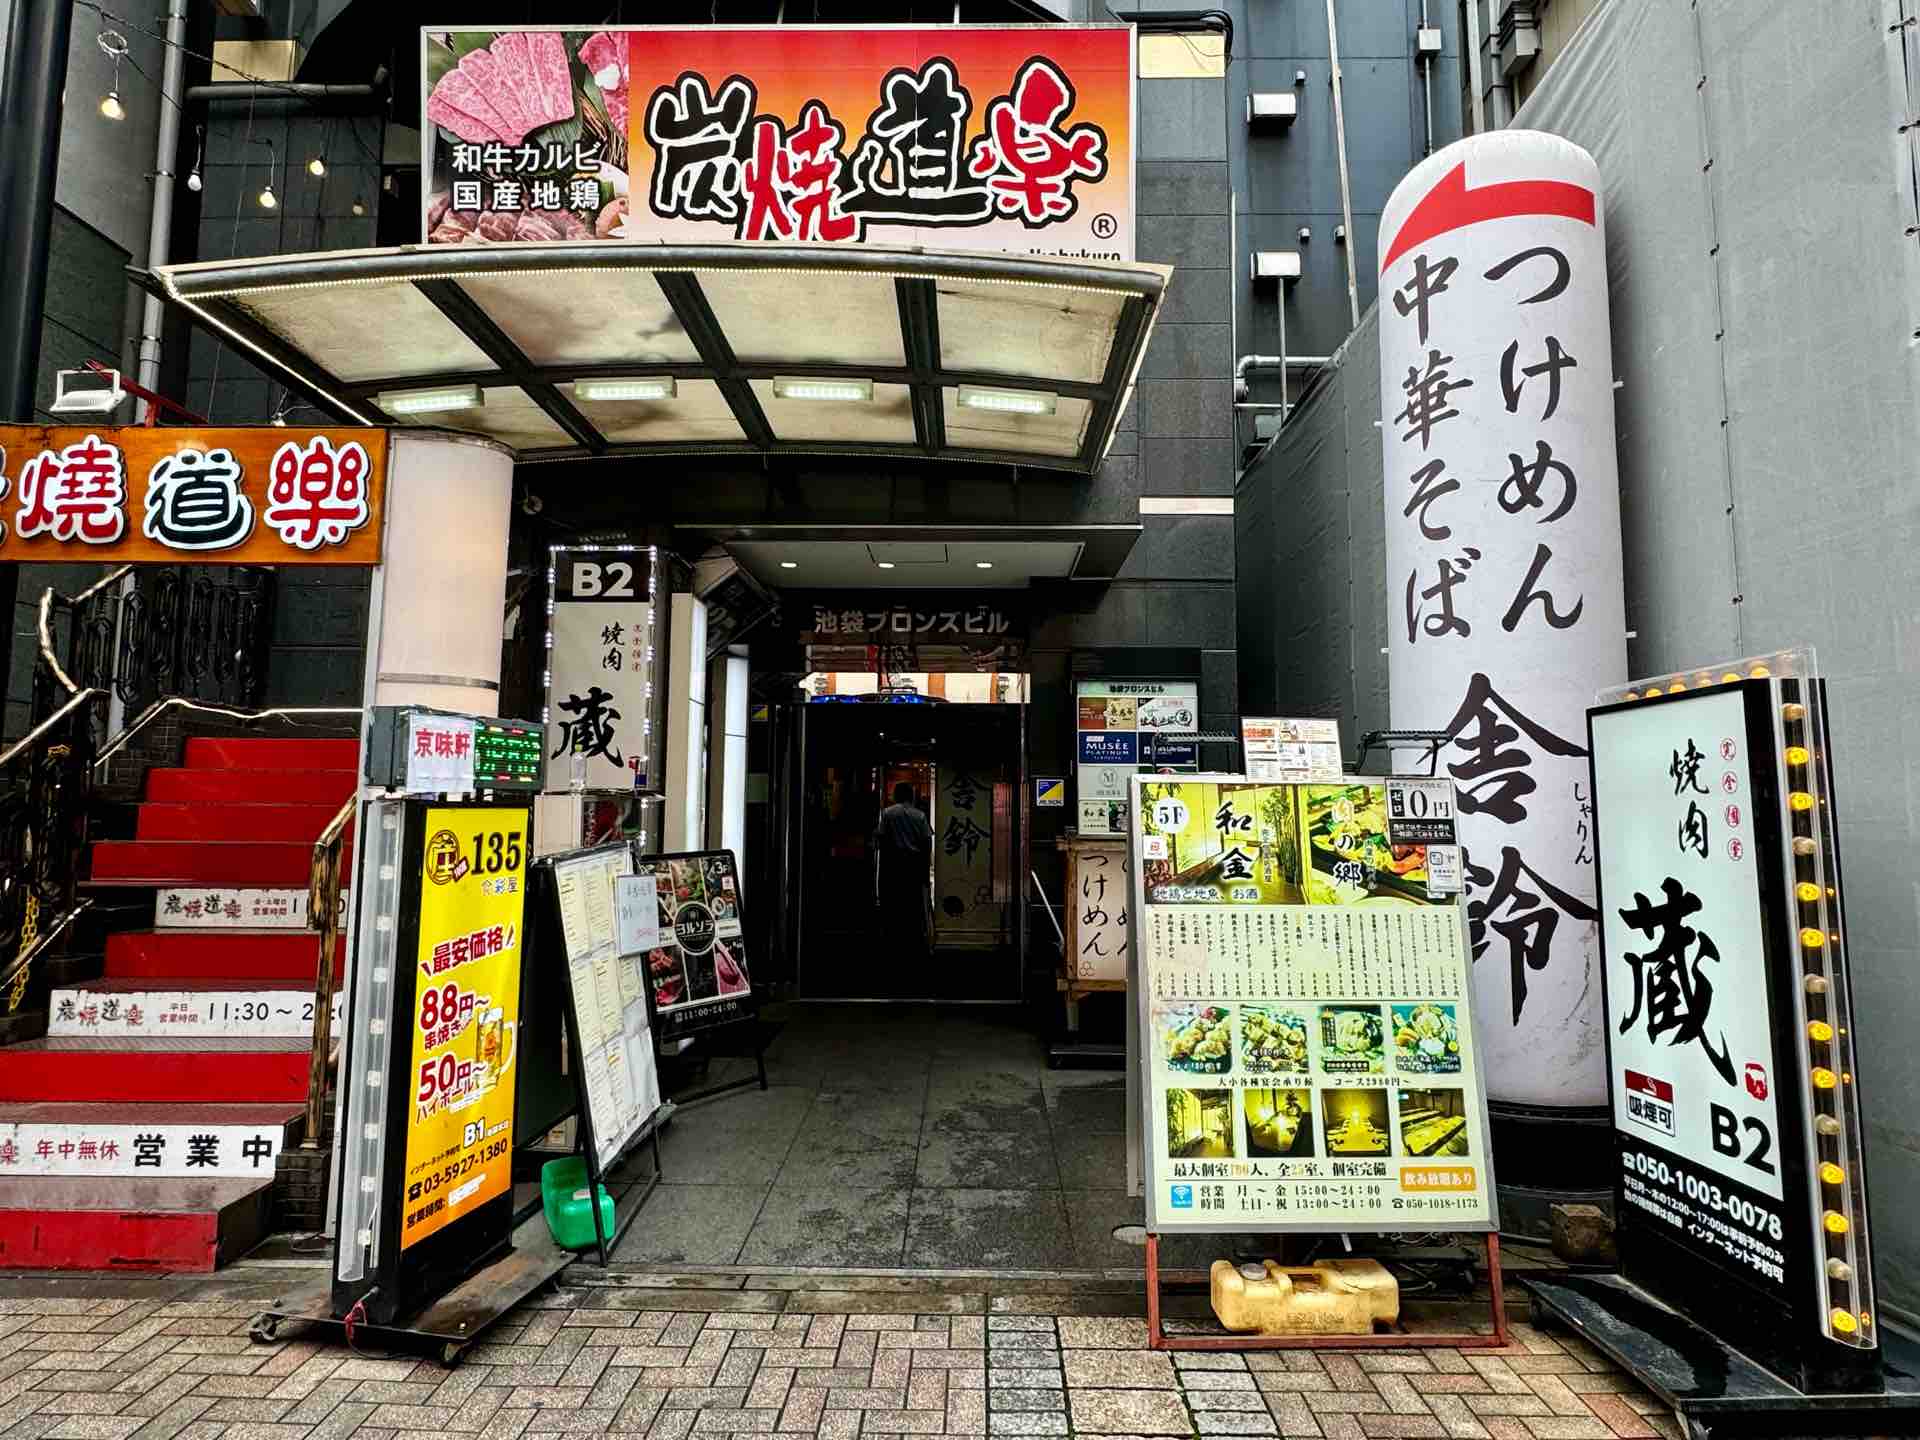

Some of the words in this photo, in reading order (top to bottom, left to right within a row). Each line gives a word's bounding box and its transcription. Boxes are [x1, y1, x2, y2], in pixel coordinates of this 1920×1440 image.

[452, 144, 600, 173] 和牛カルビ
[645, 57, 1108, 241] 炭焼道楽
[453, 181, 600, 212] 国産地鶏
[1393, 254, 1483, 644] 中華そば
[1484, 246, 1584, 633] つけめん
[0, 434, 372, 551] 燒道樂
[572, 562, 634, 597] B2
[601, 622, 625, 671] 焼肉
[814, 610, 1010, 634] 池袋ブロンズビル
[415, 730, 470, 759] 京味軒
[551, 686, 624, 768] 蔵
[1159, 805, 1184, 824] 5F
[1573, 783, 1594, 866] しゃりん
[1670, 738, 1710, 859] 焼肉
[471, 832, 521, 875] 135
[1081, 855, 1109, 956] つけめん
[433, 926, 503, 974] 最安価格
[1618, 876, 1738, 1086] 蔵
[35, 1139, 120, 1161] 年中無休
[133, 1134, 273, 1168] 営業中
[463, 1117, 486, 1149] B1
[1710, 1102, 1775, 1176] B2
[423, 1138, 508, 1194] 03-5927-1380
[1636, 1152, 1784, 1241] 050-1003-0078
